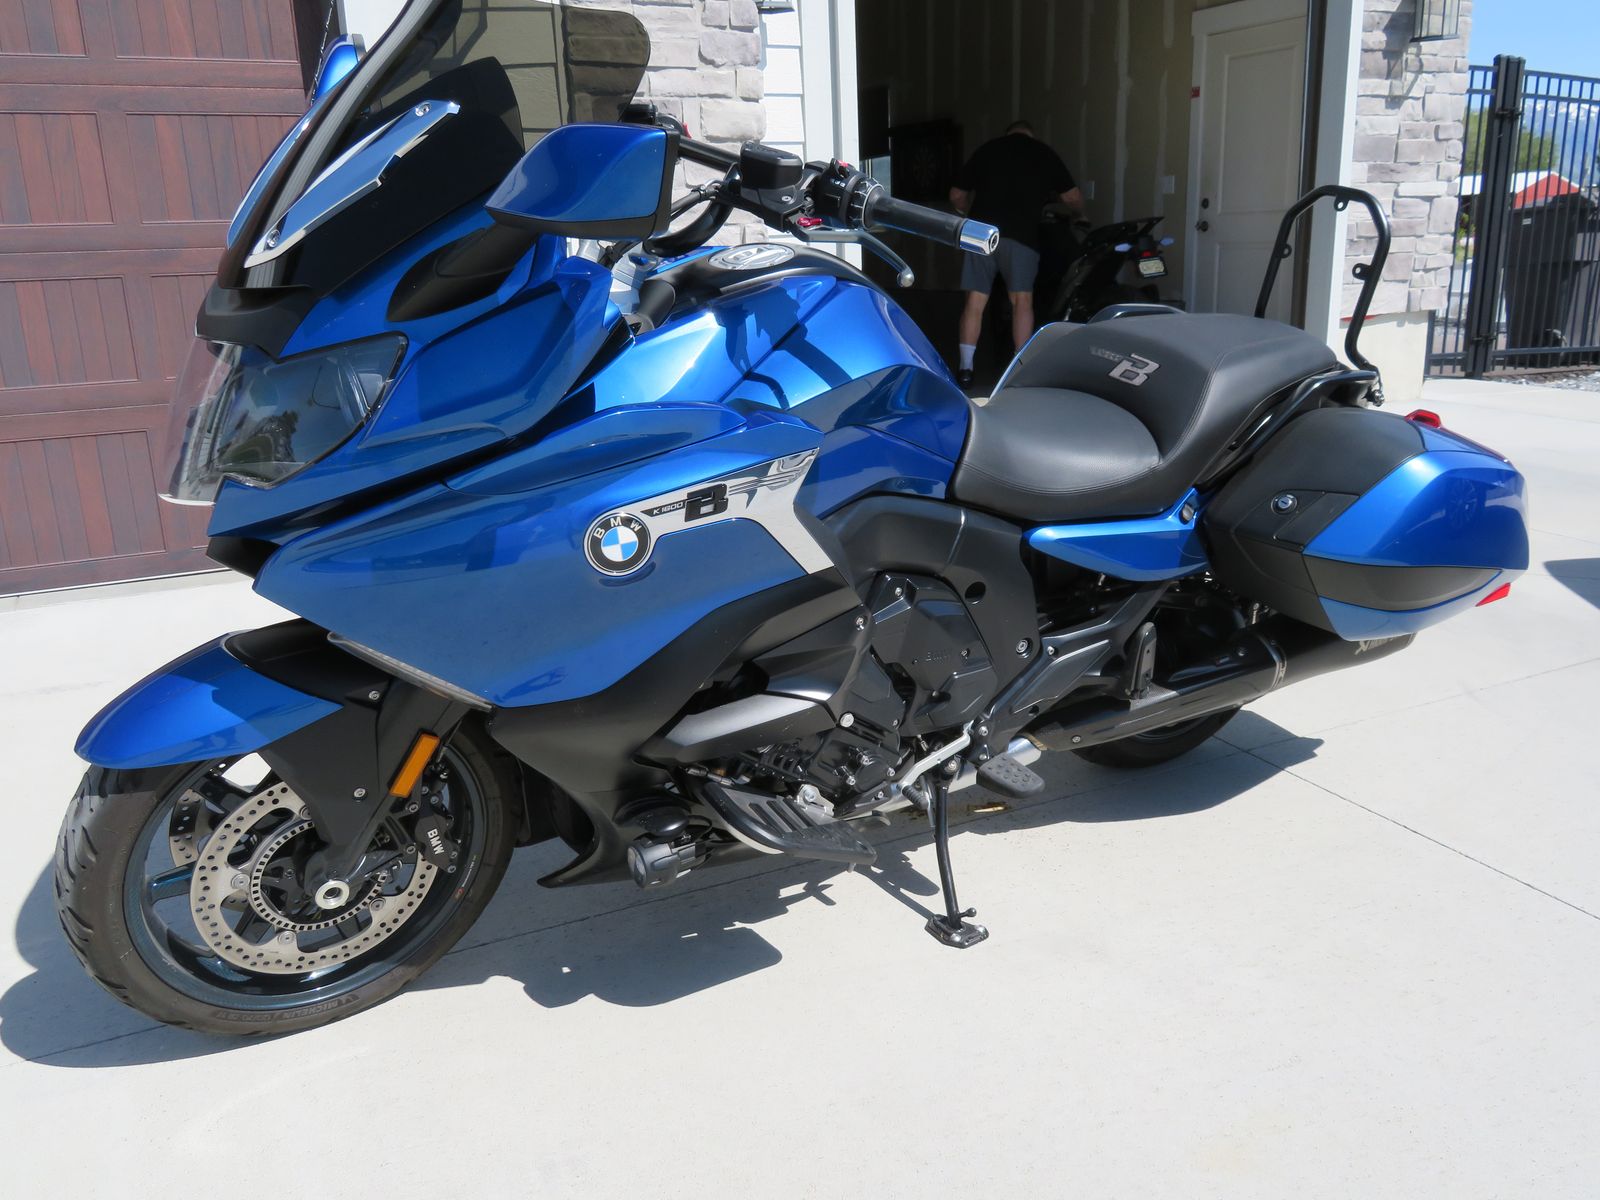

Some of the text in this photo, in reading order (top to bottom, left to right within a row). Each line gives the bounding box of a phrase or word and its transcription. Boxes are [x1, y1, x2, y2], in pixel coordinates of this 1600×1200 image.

[652, 483, 729, 522] K 1600 B
[593, 516, 642, 539] BMW
[427, 828, 445, 855] BMW
